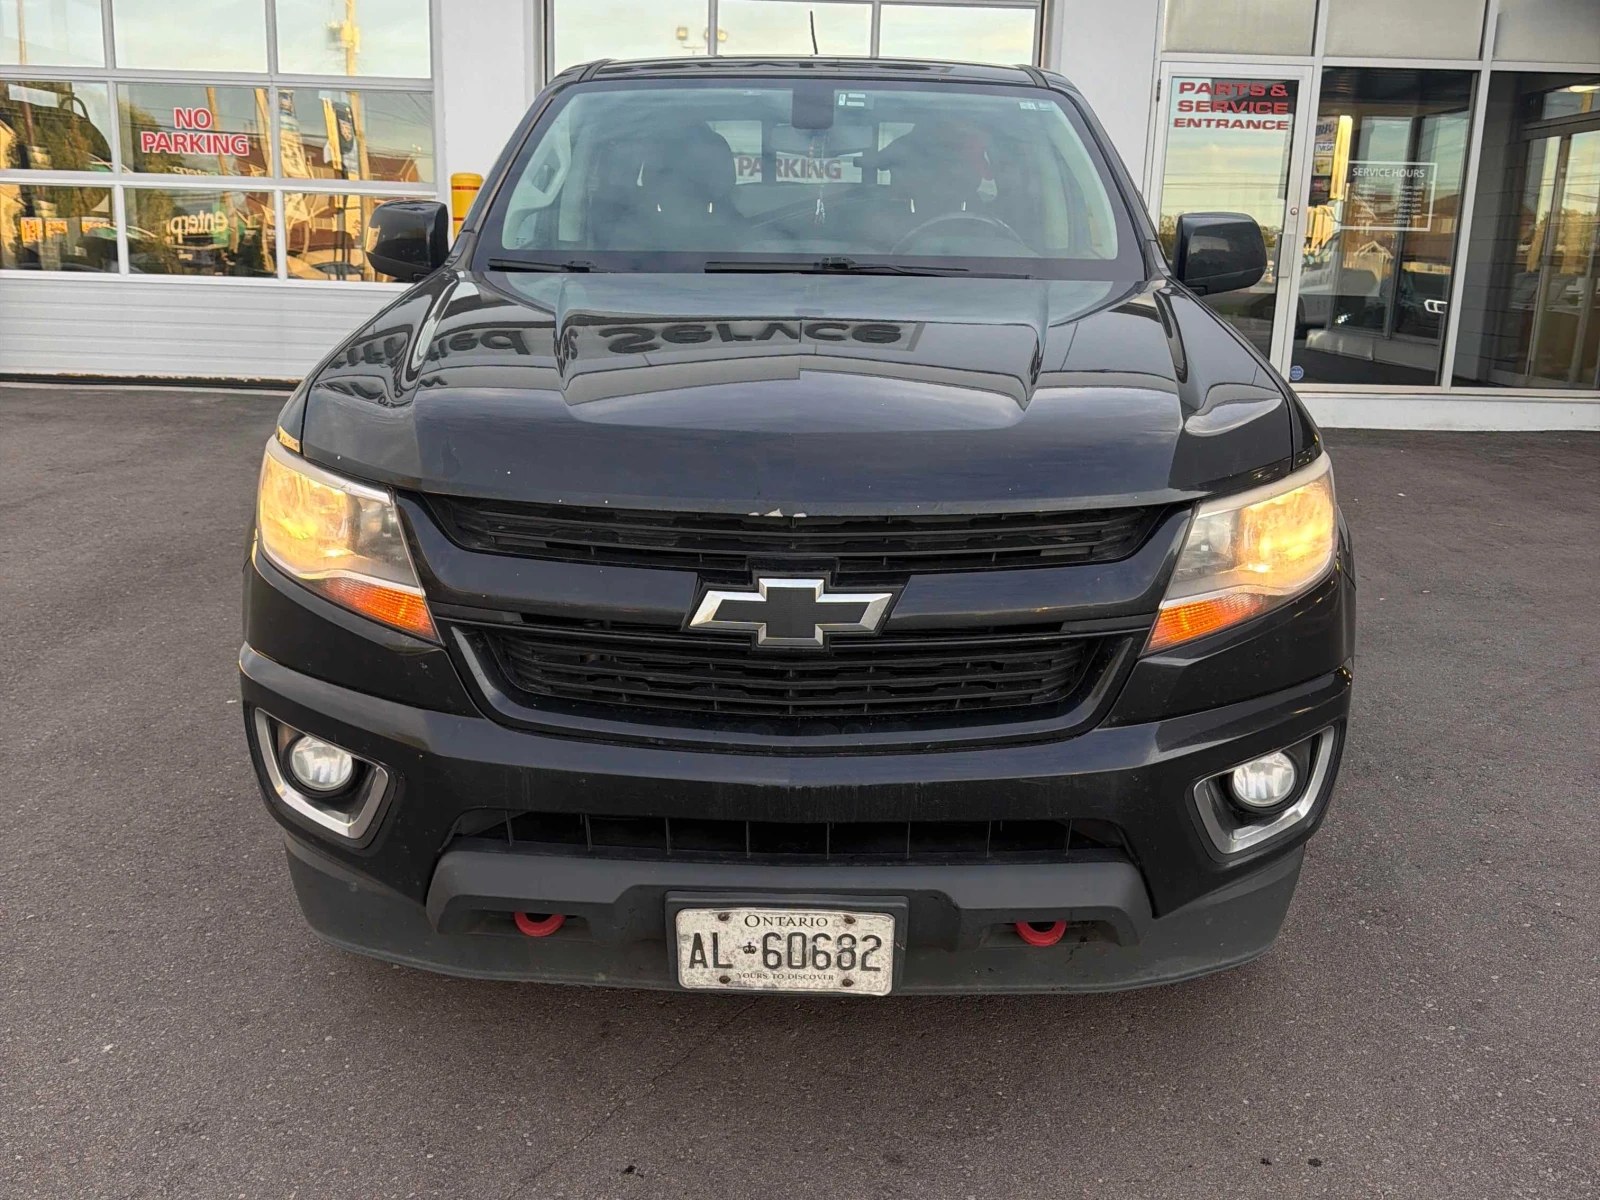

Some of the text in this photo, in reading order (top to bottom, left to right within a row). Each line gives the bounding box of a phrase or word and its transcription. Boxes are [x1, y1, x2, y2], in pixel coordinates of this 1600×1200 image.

[1179, 82, 1288, 97] PARTS &
[1177, 100, 1288, 115] SERVICE
[174, 107, 212, 130] NO
[1173, 118, 1289, 130] ENTRANCE
[141, 132, 249, 156] PARKING
[1352, 167, 1425, 178] SERVICE HOURS
[744, 914, 828, 928] ONTARIO
[688, 932, 882, 972] AL 60682
[737, 972, 768, 980] YOURS
[787, 973, 835, 981] DISCOVER
